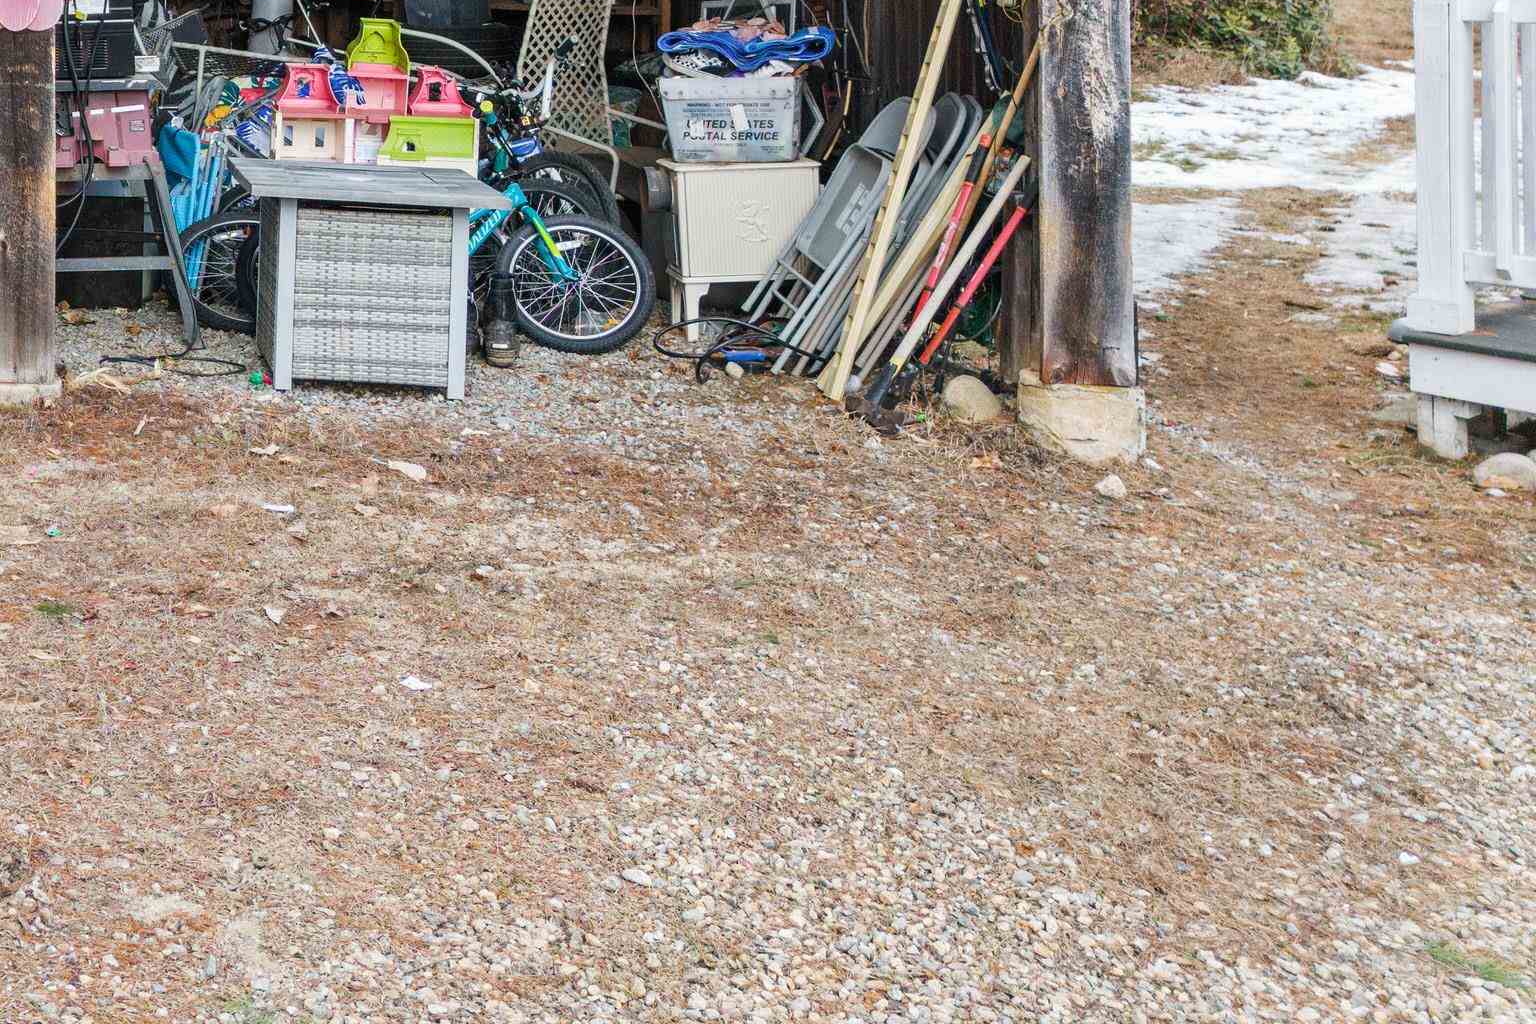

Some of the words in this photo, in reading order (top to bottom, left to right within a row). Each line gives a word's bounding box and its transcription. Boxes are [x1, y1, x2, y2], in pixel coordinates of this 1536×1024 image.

[687, 119, 727, 129] UITED
[730, 119, 774, 129] STES
[730, 131, 780, 141] SERVICE
